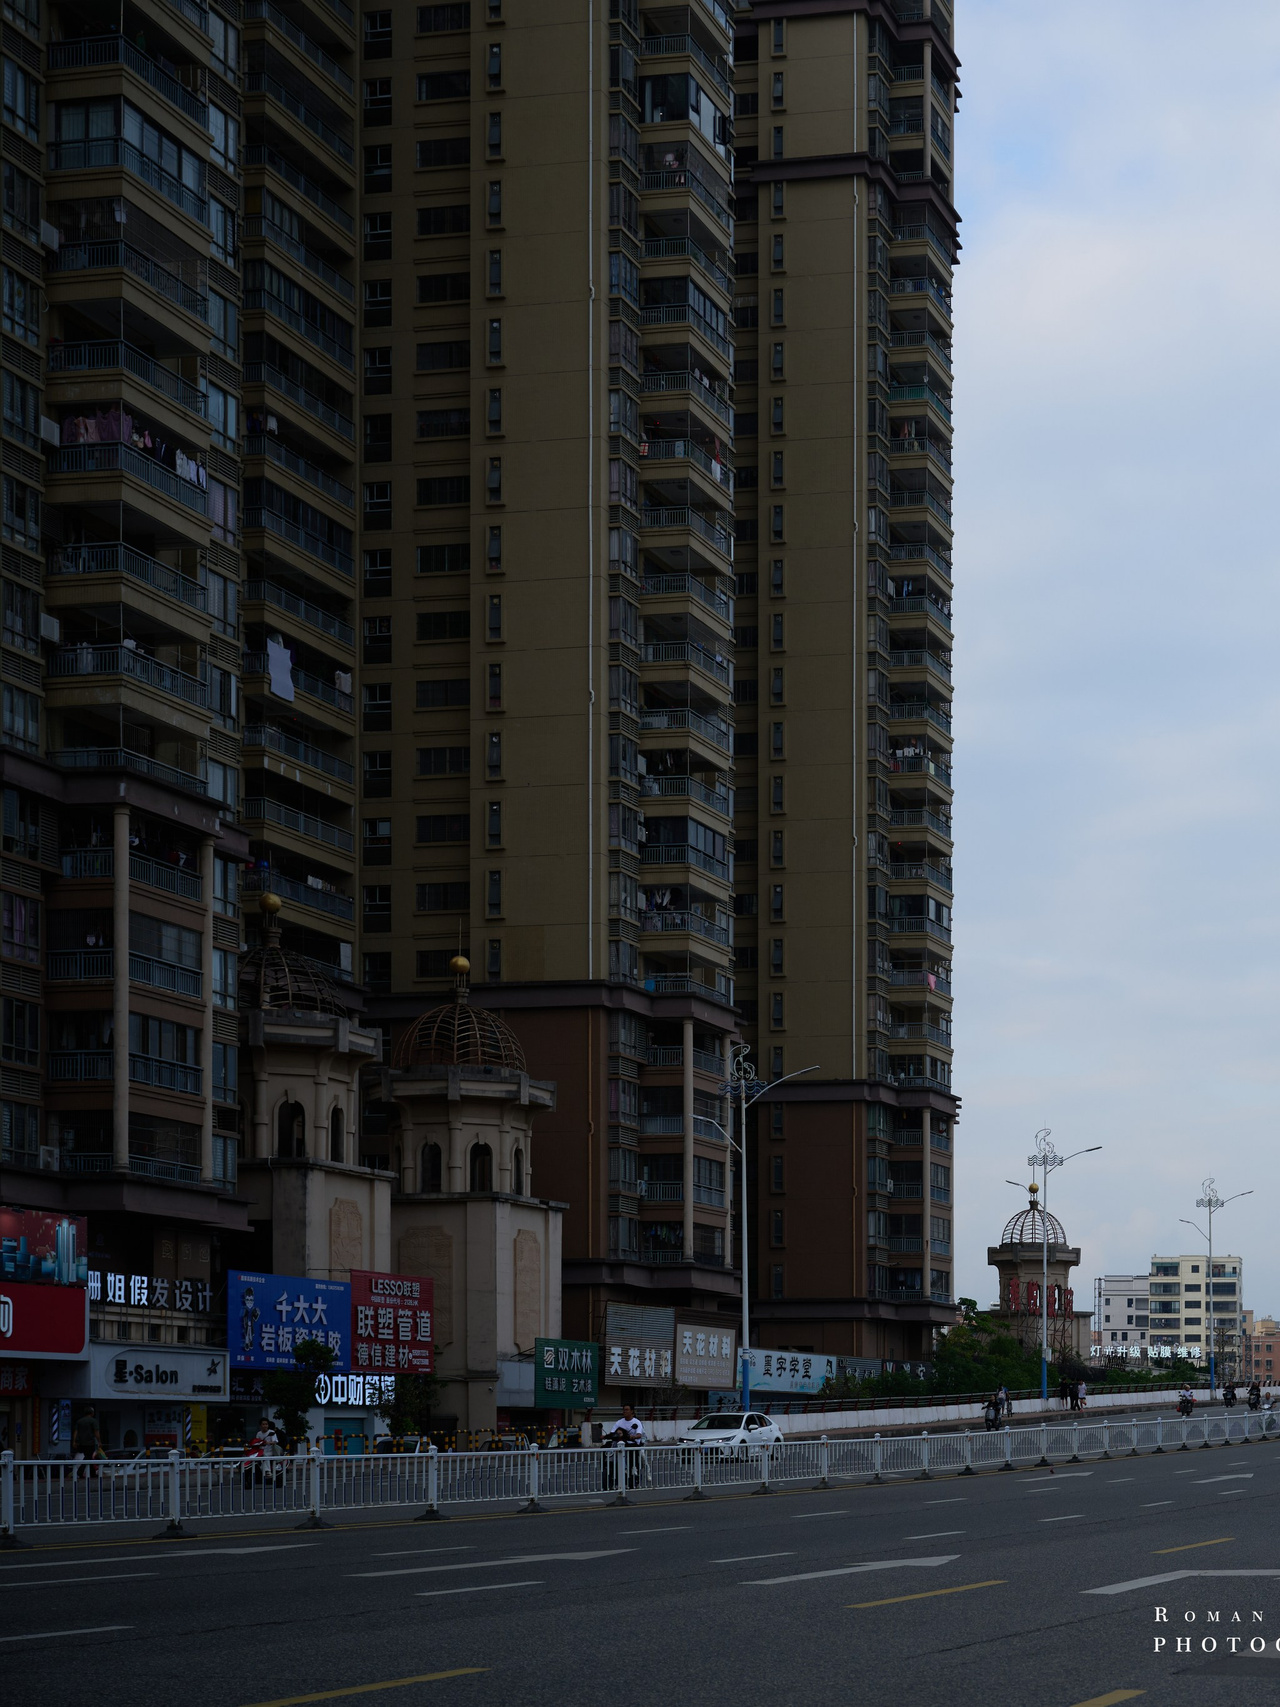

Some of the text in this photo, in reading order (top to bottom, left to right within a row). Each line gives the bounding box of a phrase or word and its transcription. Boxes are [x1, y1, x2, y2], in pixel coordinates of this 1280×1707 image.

[276, 1290, 328, 1325] 千大大
[357, 1305, 432, 1342] 联塑管道
[357, 1342, 409, 1369] 德信建材
[682, 1331, 731, 1359] 天花材料
[1090, 1344, 1202, 1358] 灯光升级 贴膜 维修
[558, 1348, 592, 1374] 双木林
[609, 1347, 672, 1378] 天花材料
